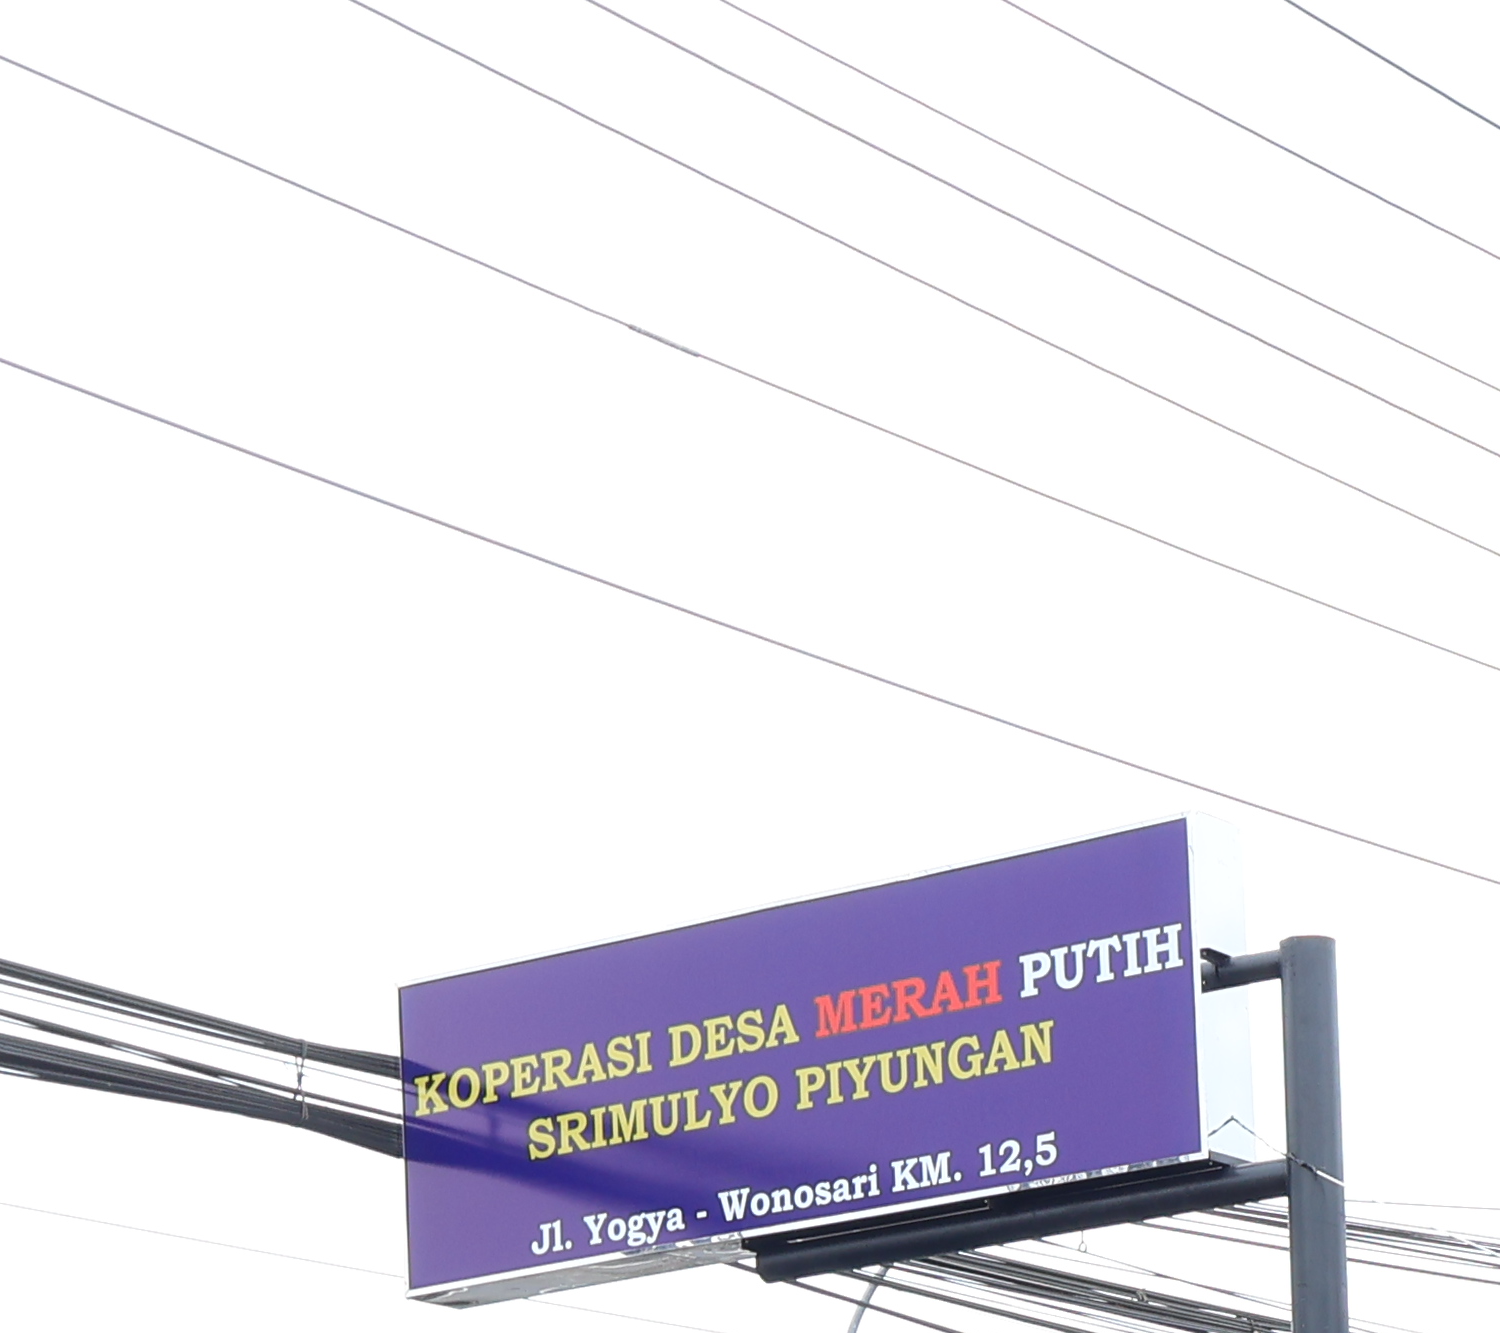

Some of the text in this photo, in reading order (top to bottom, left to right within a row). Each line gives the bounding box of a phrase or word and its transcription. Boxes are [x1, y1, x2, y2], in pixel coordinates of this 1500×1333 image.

[414, 923, 1184, 1117] KOPERASI DESA MERAH PUTIH
[527, 1020, 1055, 1161] SRIMULYO PIYUNGAN
[531, 1219, 573, 1257] Jl.
[583, 1205, 686, 1253] Yogya
[717, 1167, 881, 1223] Wonosari
[890, 1151, 961, 1195] KM.
[978, 1131, 1059, 1183] 12,5
